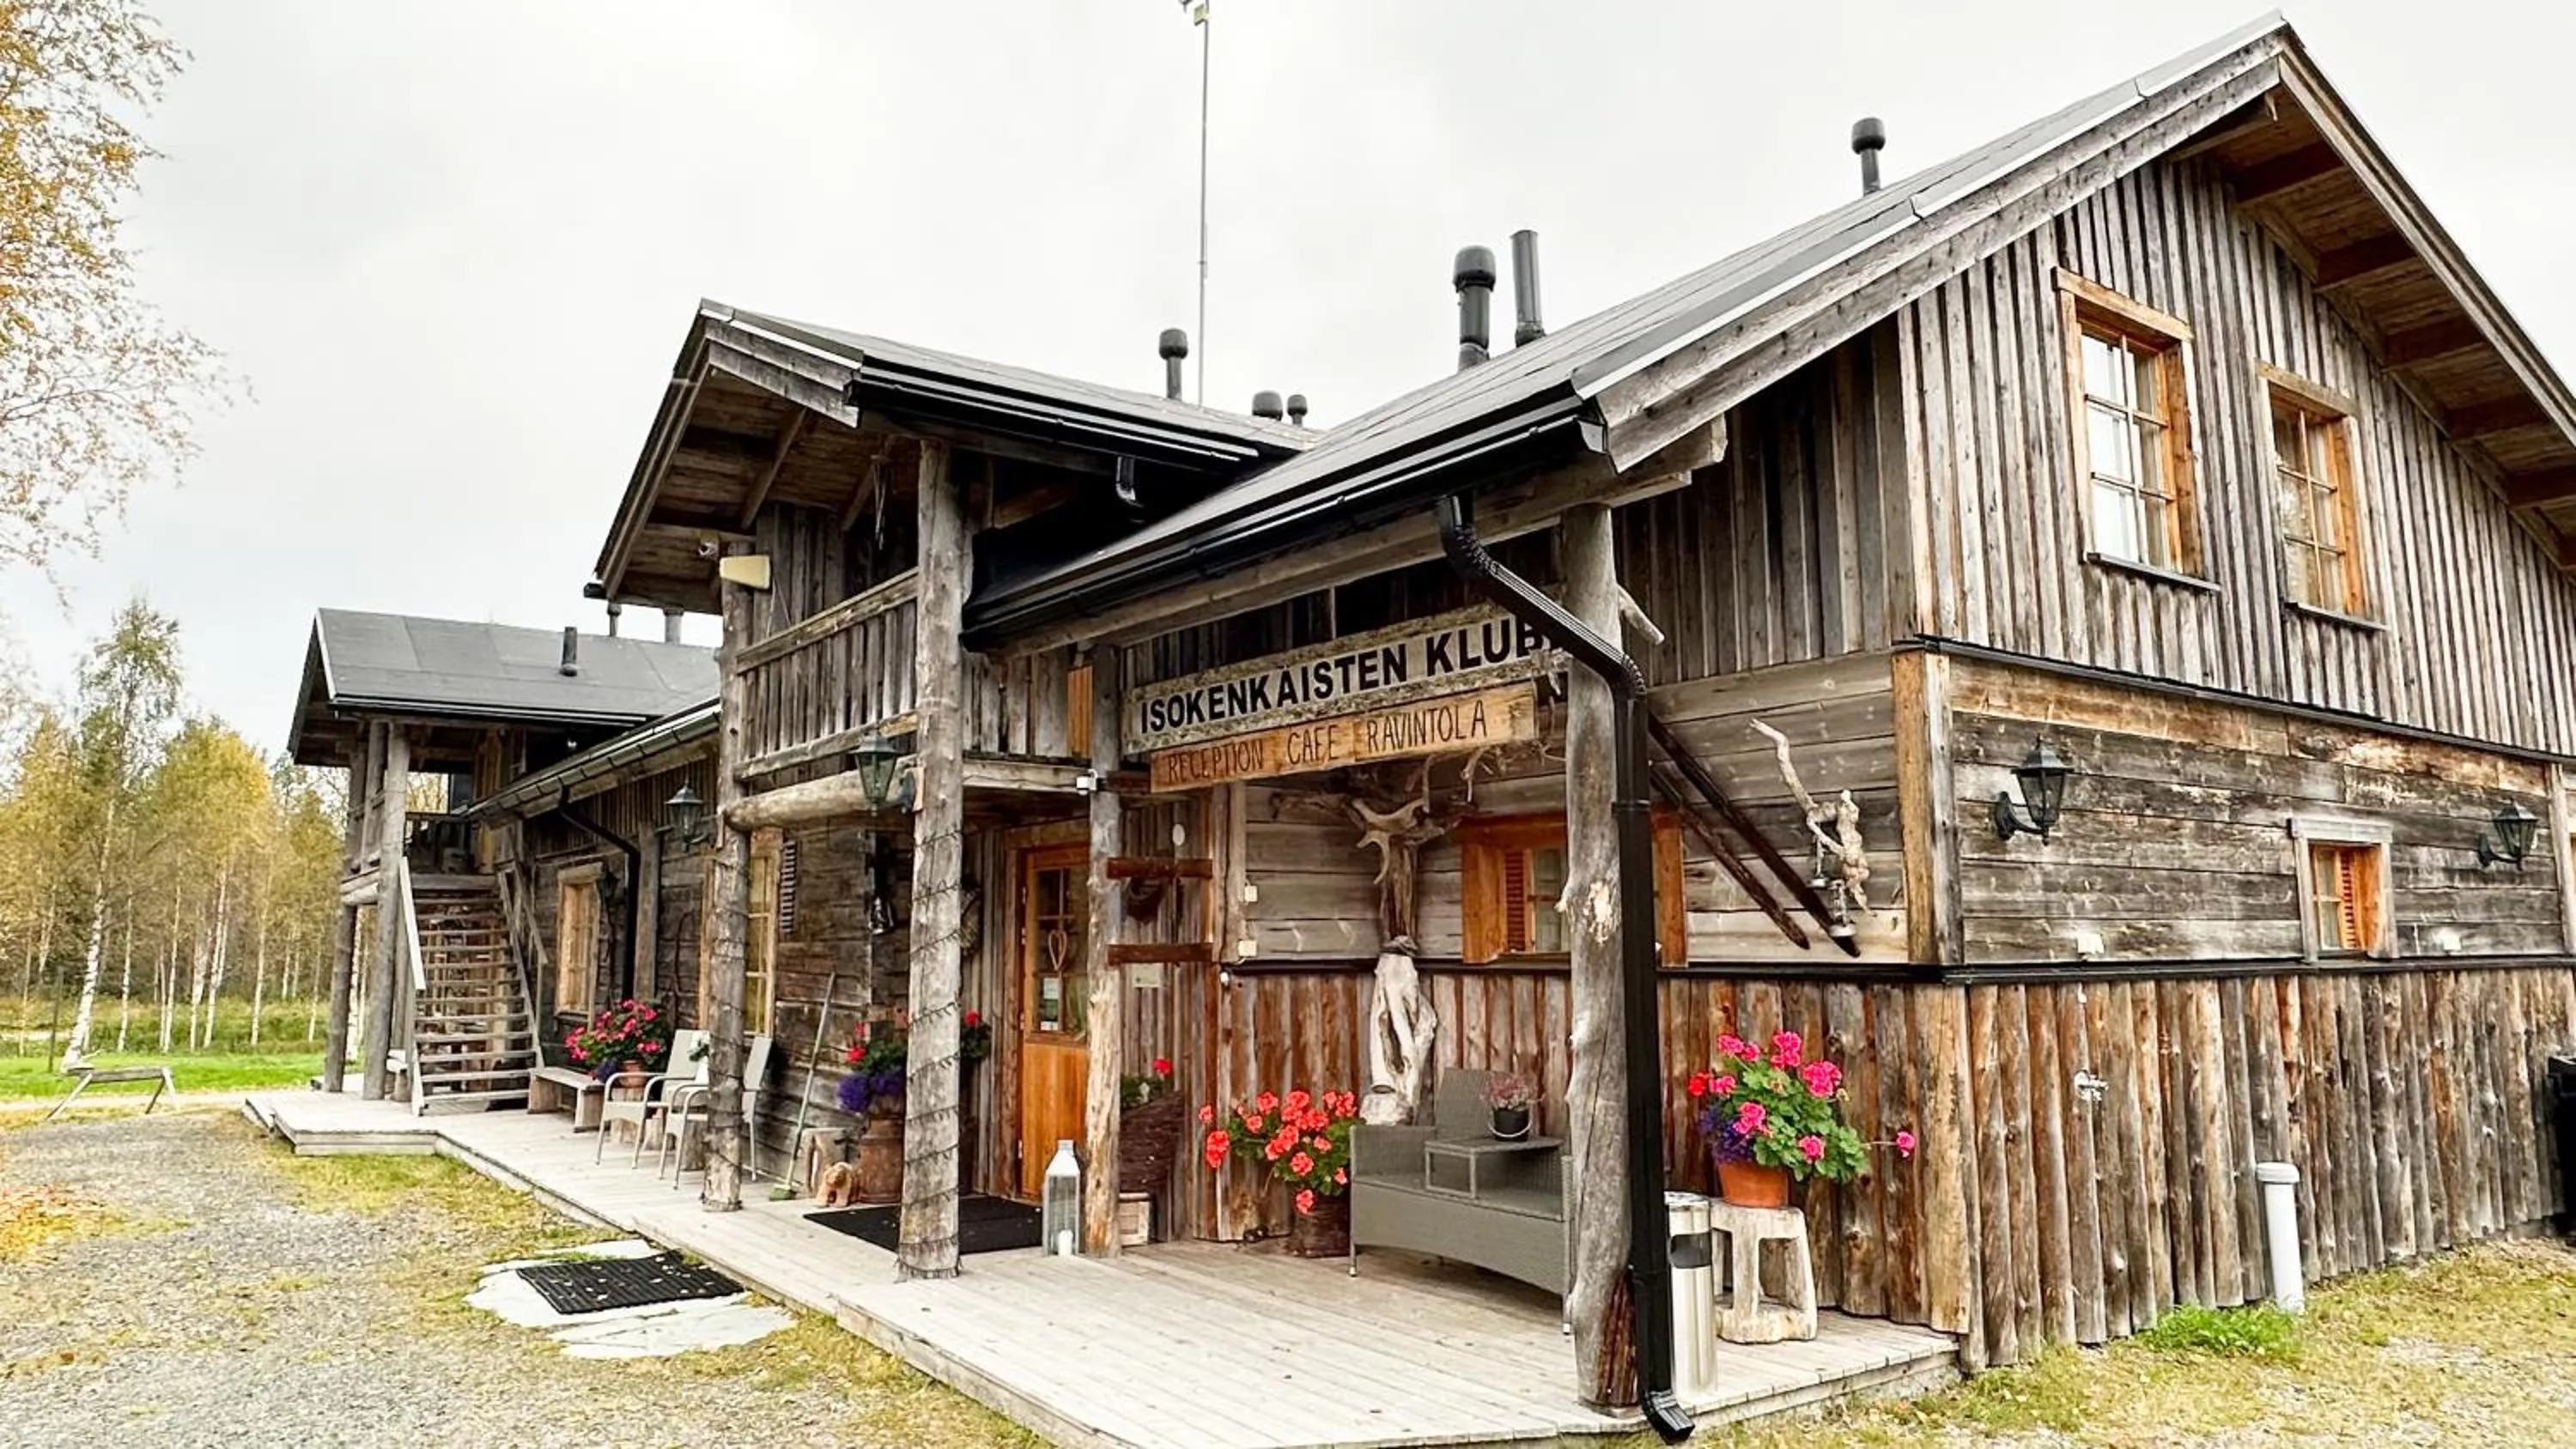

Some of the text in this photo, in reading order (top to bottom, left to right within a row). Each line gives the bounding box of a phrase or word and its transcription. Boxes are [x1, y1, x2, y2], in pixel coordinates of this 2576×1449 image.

[1167, 700, 1487, 783] RECEPTION CAFE RAVINTOLA
